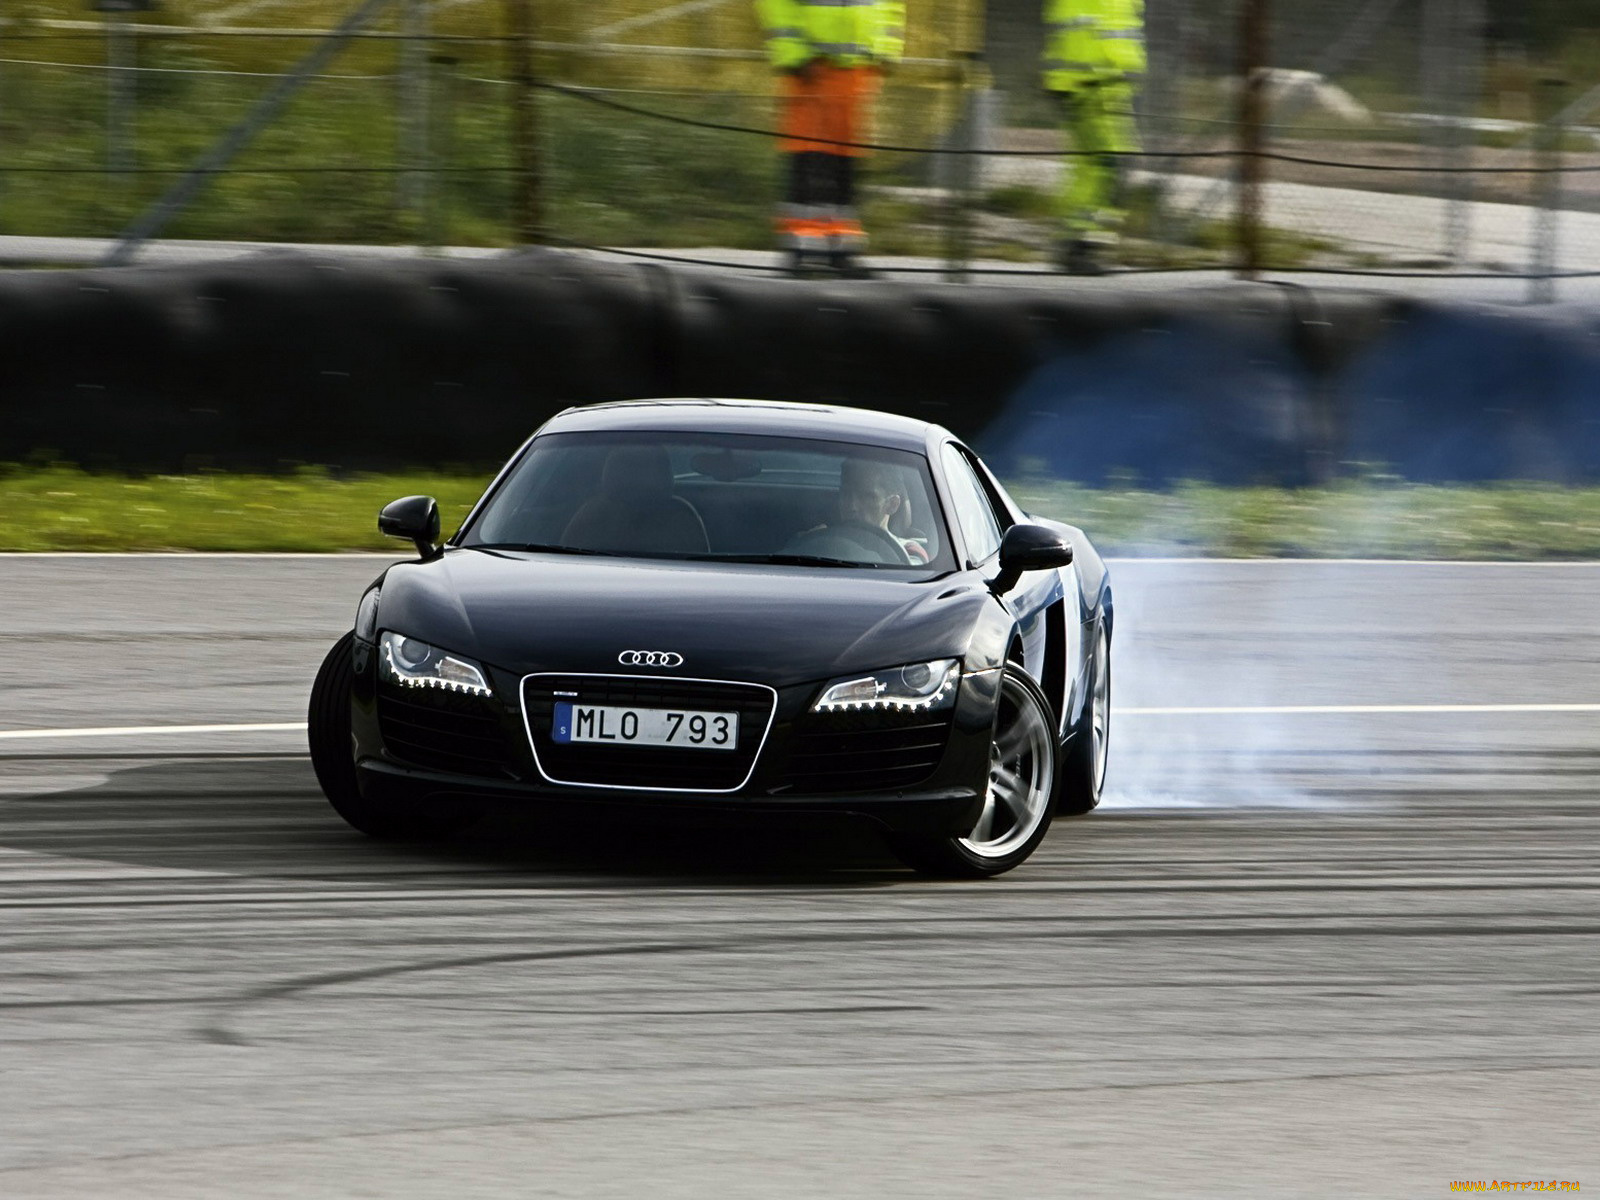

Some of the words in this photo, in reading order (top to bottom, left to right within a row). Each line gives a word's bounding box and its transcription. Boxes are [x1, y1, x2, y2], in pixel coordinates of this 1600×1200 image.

[560, 726, 567, 735] S
[576, 709, 638, 740] MLO
[665, 713, 729, 745] 793
